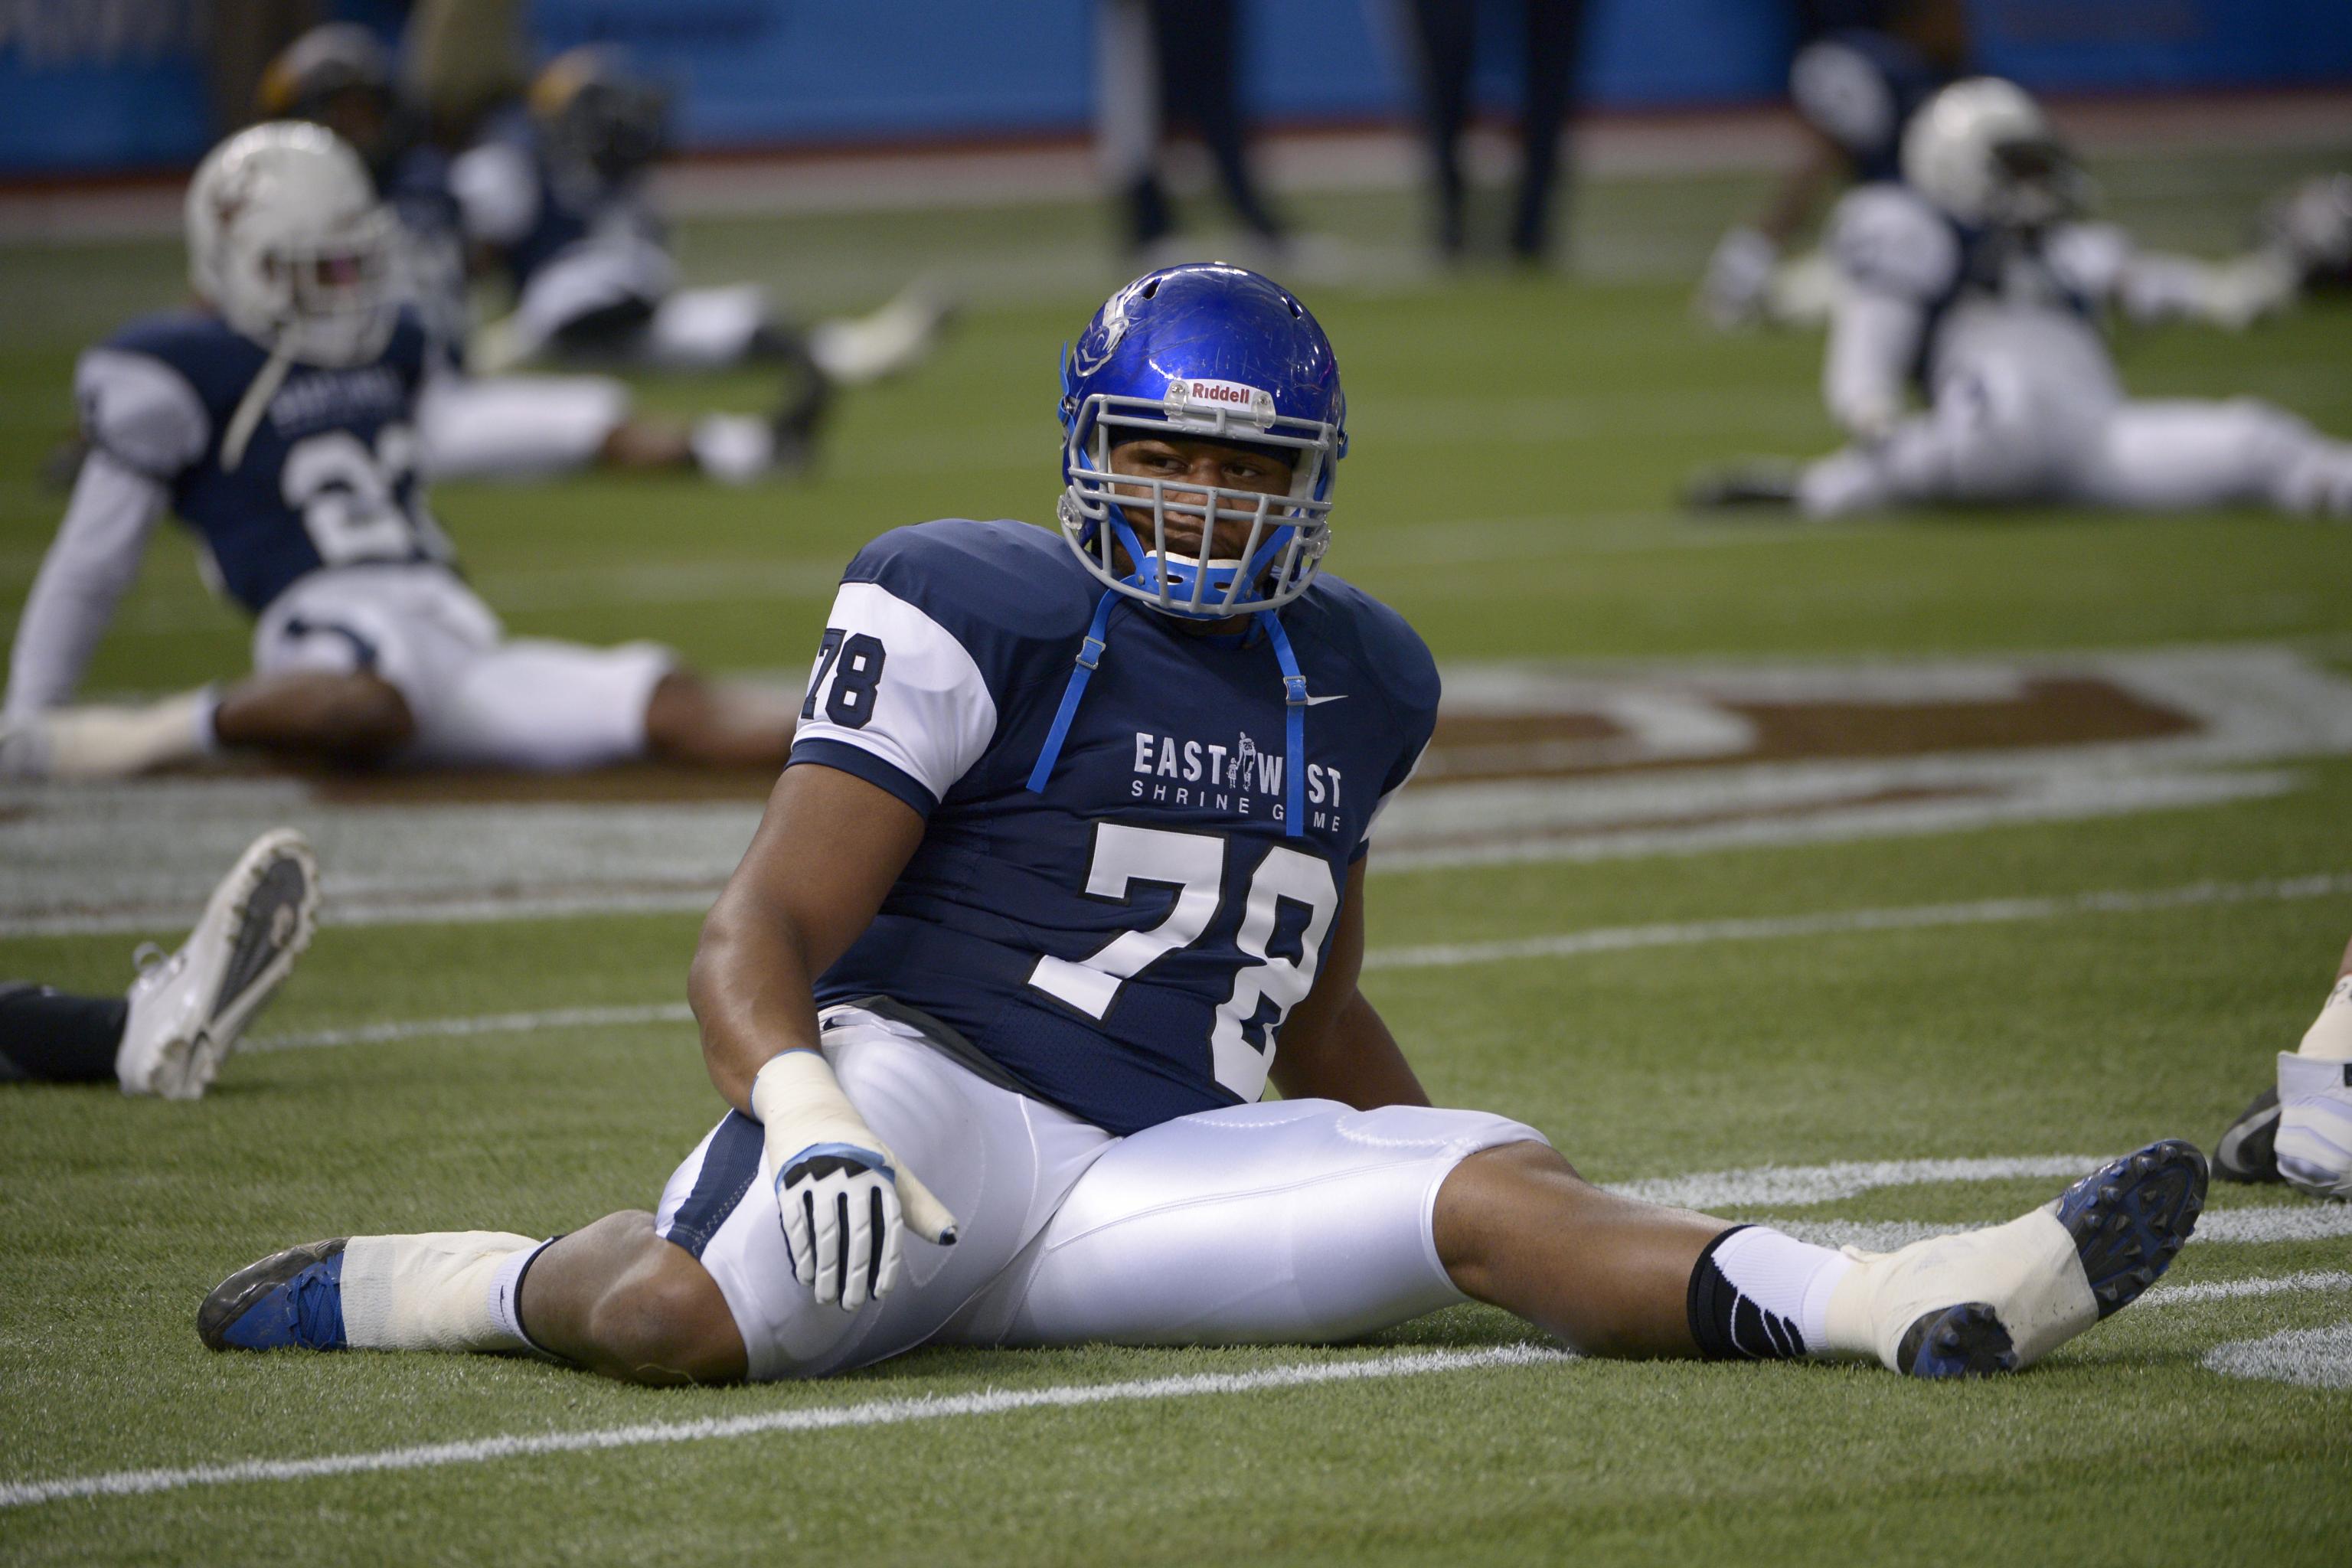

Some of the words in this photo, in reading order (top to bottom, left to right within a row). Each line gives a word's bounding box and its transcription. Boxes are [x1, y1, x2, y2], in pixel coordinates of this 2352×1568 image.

[1192, 382, 1250, 404] Riddell
[801, 628, 887, 730] 78
[1131, 779, 1250, 814] SHRINE
[1272, 804, 1340, 832] GME
[1134, 732, 1227, 785] EAST
[1258, 753, 1341, 808] WST
[1027, 822, 1338, 1104] 78
